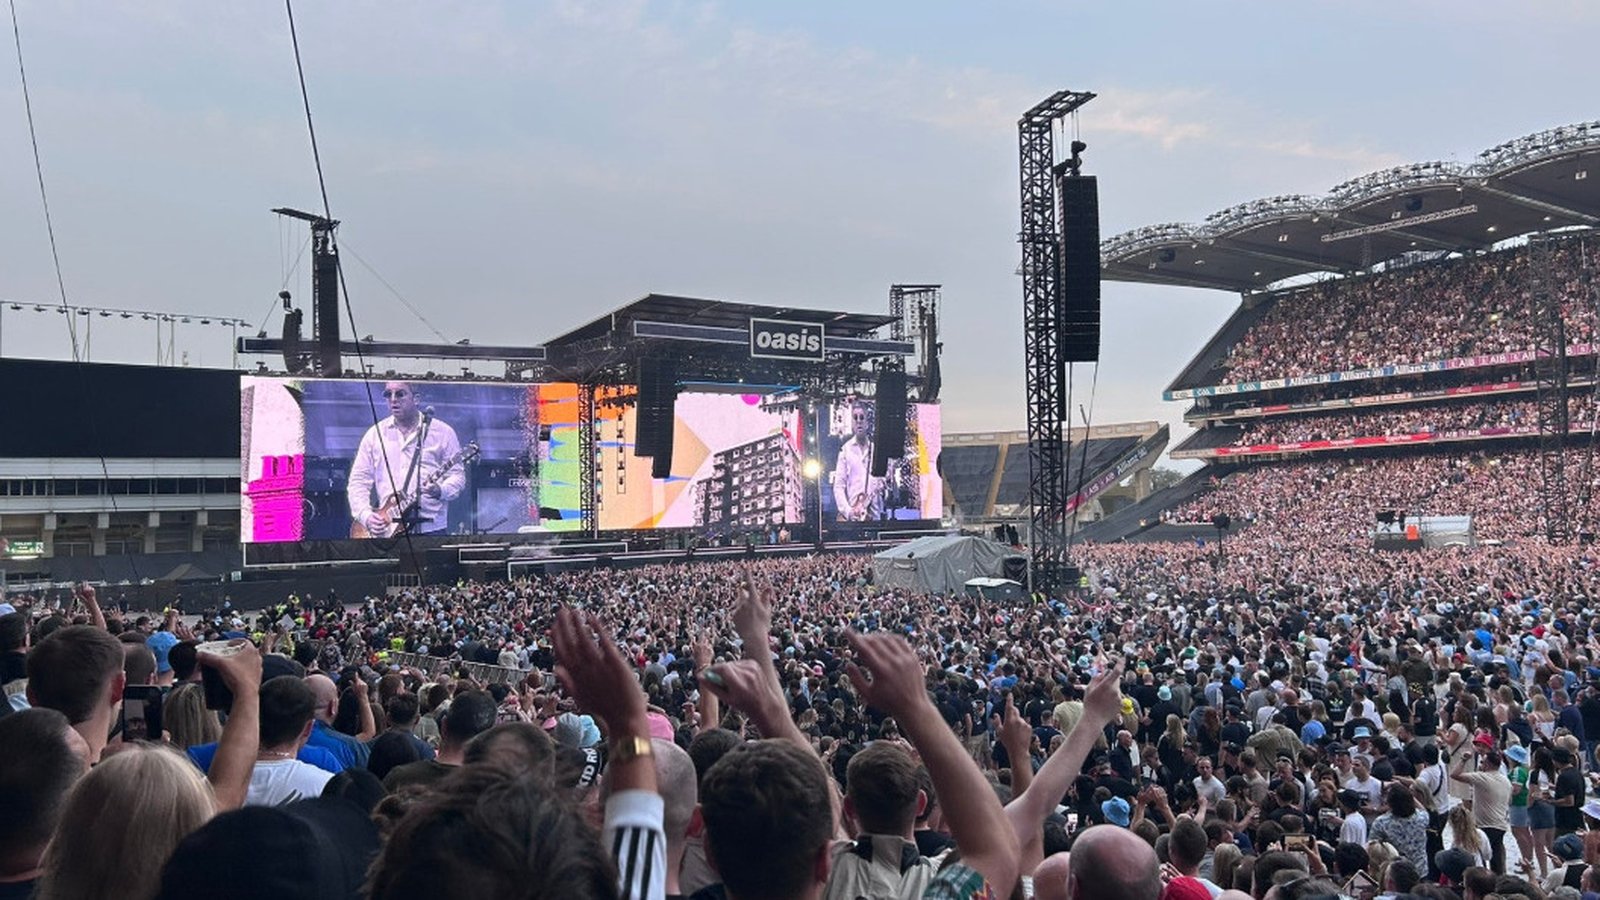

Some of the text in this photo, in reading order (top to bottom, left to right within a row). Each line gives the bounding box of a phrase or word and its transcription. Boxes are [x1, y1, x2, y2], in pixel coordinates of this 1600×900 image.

[756, 328, 820, 352] oasis
[1490, 354, 1506, 364] AIB
[1393, 365, 1427, 375] Allianz
[1340, 370, 1371, 381] Allianz
